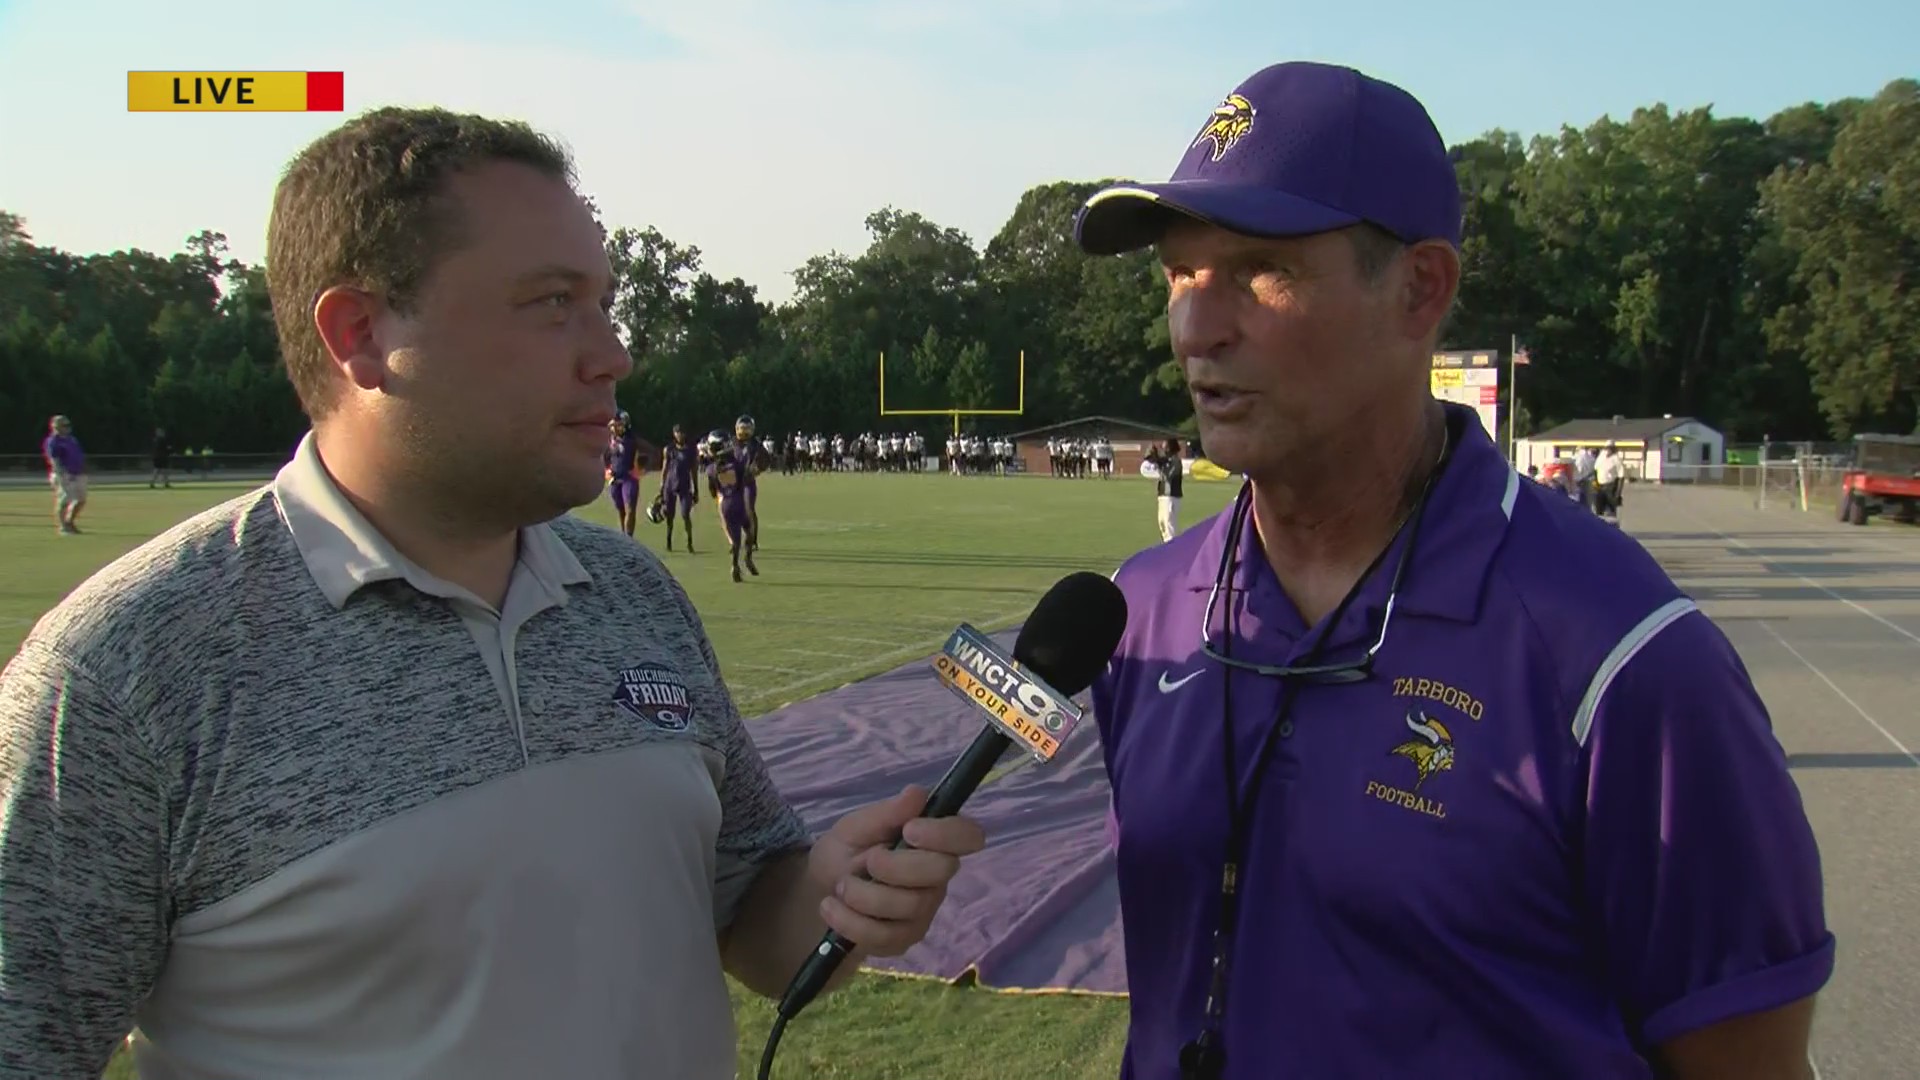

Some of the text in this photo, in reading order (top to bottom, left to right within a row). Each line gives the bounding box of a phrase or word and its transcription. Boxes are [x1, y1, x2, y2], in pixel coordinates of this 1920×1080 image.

[625, 683, 689, 708] FRIDAY
[937, 656, 1051, 753] ON YOUR SIDE
[1392, 677, 1484, 721] TARBORO
[1365, 780, 1447, 819] FOOTBALL
